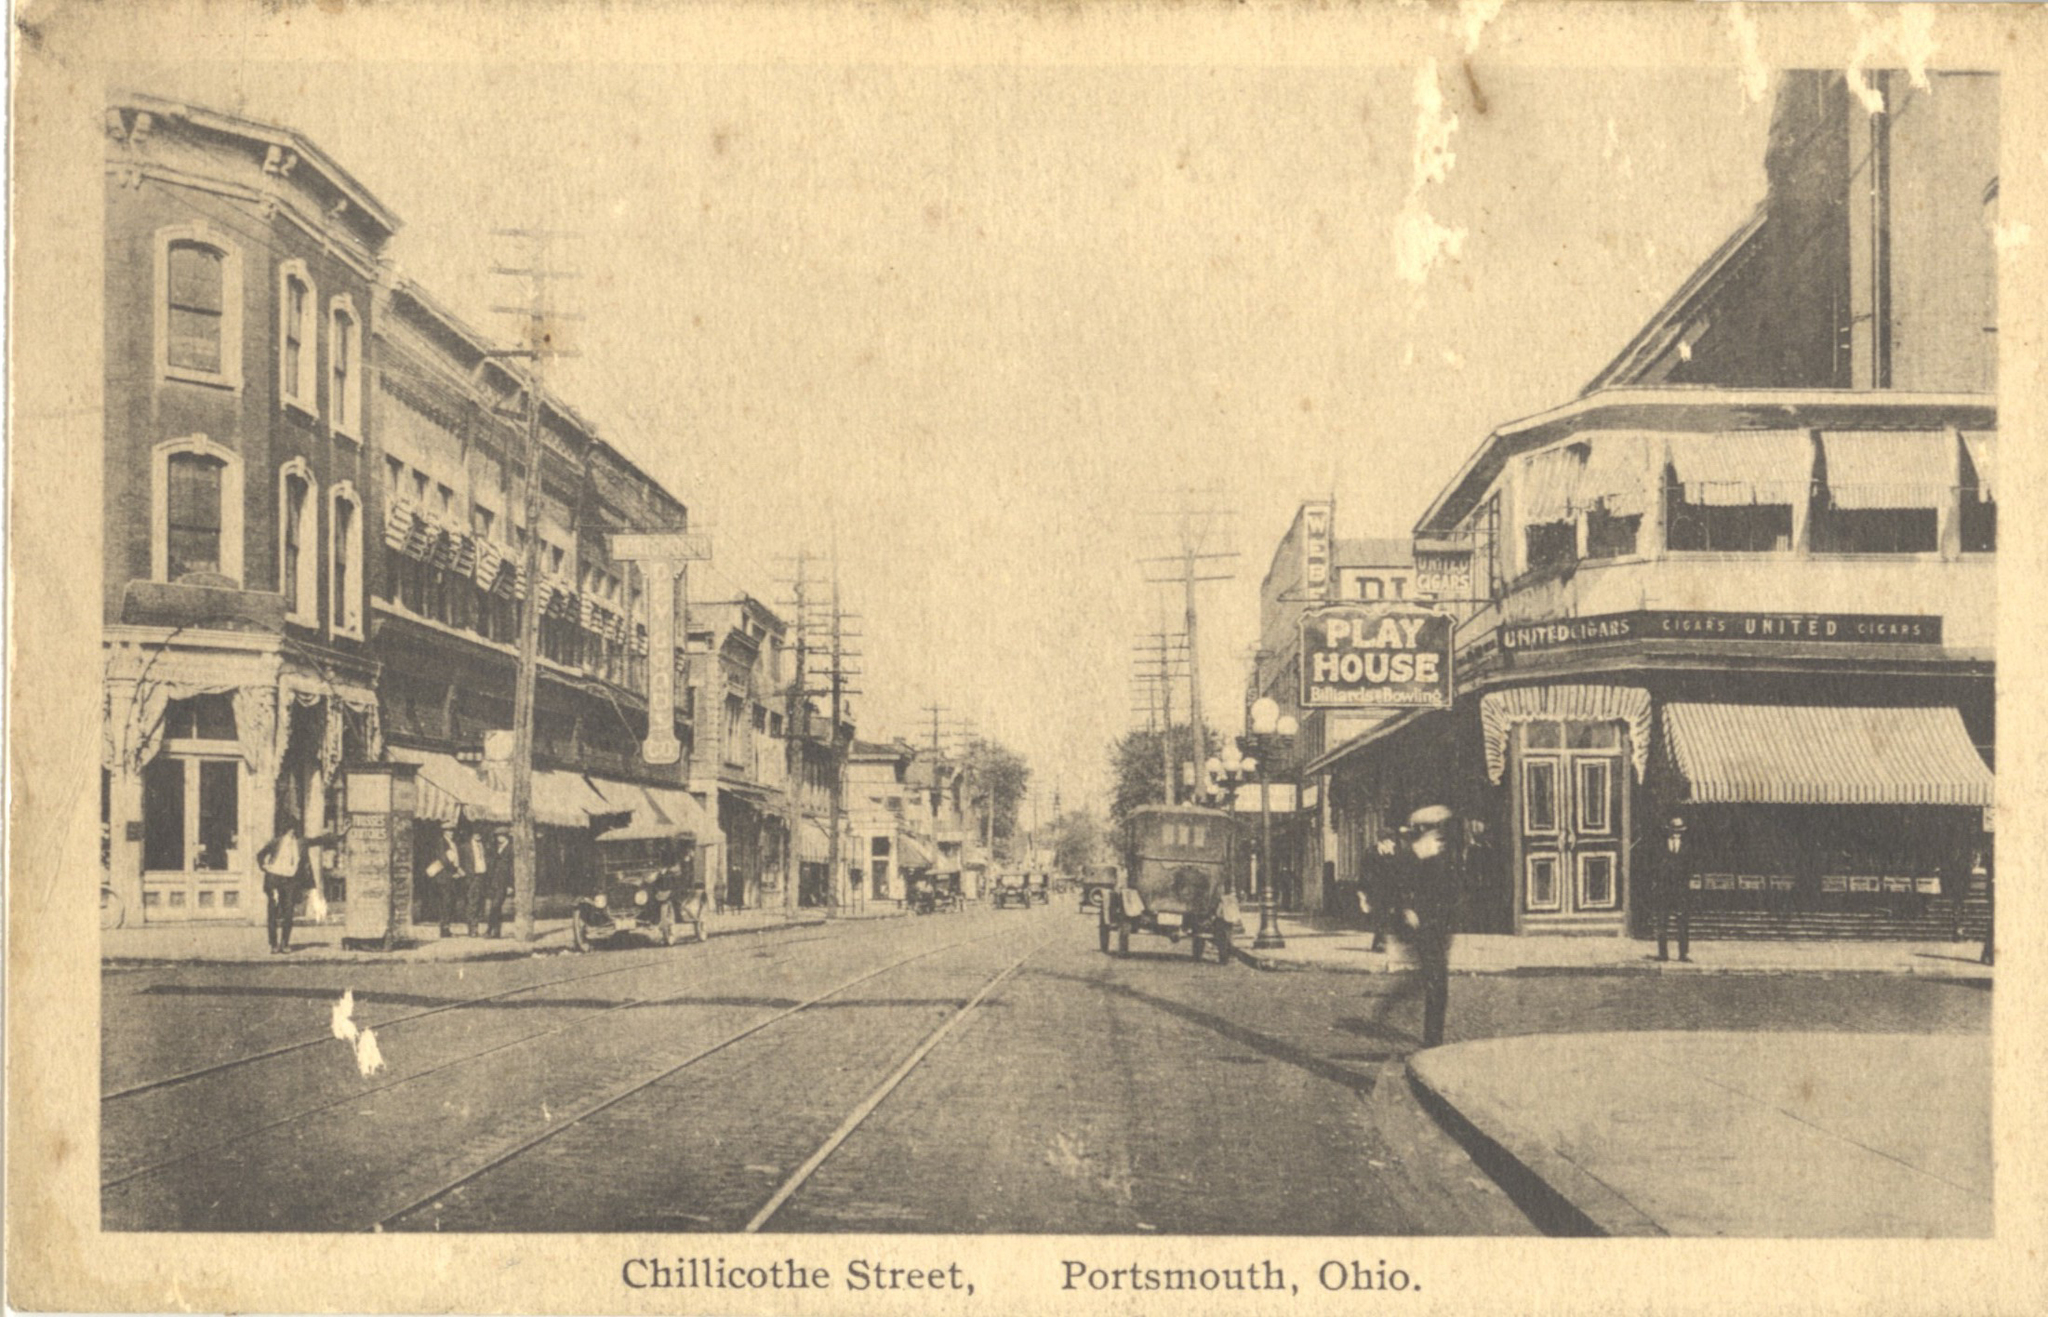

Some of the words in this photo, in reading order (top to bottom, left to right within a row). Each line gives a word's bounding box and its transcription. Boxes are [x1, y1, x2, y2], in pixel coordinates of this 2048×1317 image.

[1417, 574, 1470, 590] CIGARS
[1326, 618, 1425, 648] PLAY
[1504, 625, 1570, 648] UNITED
[1571, 619, 1630, 640] CIGARS
[1662, 619, 1726, 632] CIGARS
[1745, 619, 1837, 636] UNITED
[1858, 623, 1921, 636] CIGARS
[1313, 652, 1439, 682] HOUSE
[1310, 686, 1375, 702] Billiards
[1383, 686, 1442, 708] Bowling
